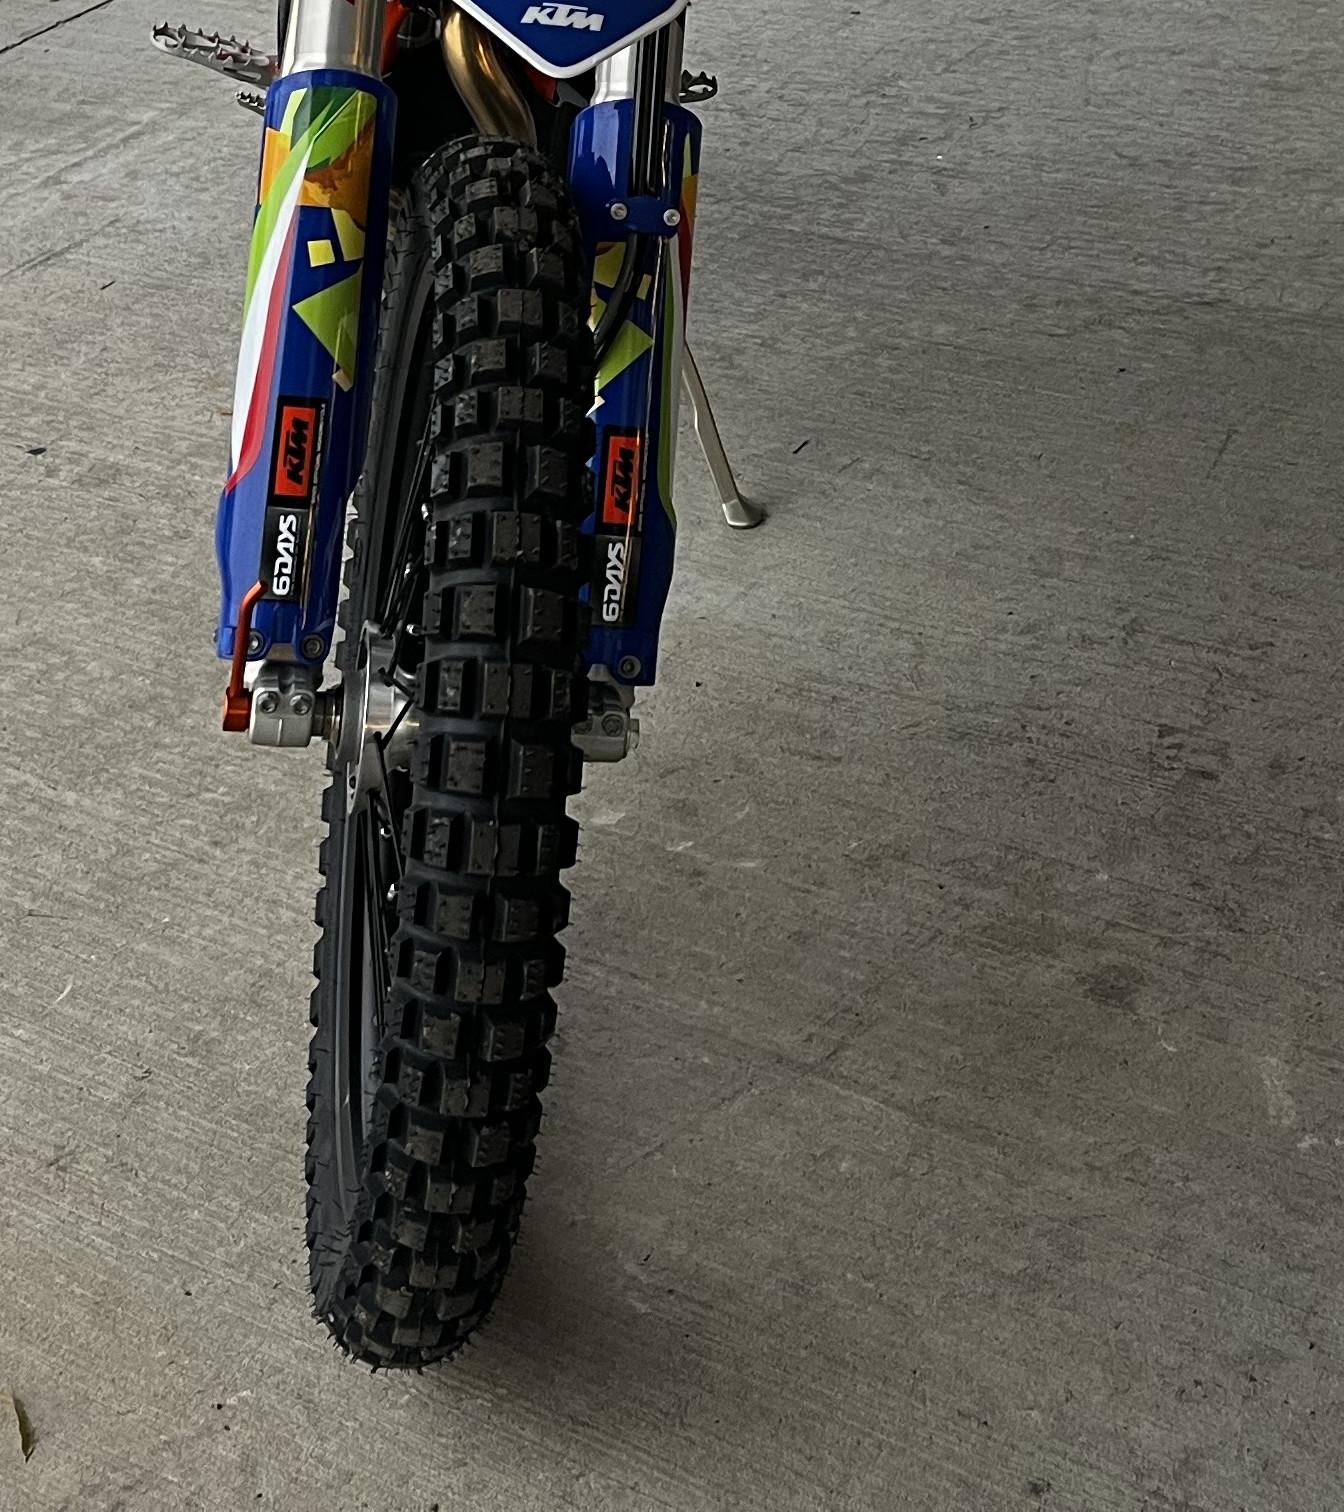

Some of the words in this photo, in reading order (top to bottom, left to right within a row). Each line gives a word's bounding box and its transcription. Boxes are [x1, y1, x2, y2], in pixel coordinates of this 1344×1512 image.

[520, 2, 605, 32] KTM
[283, 416, 310, 486] KTM
[610, 446, 635, 514] KTM
[272, 514, 298, 597] 6DAYS
[602, 542, 625, 623] 6DAYS
